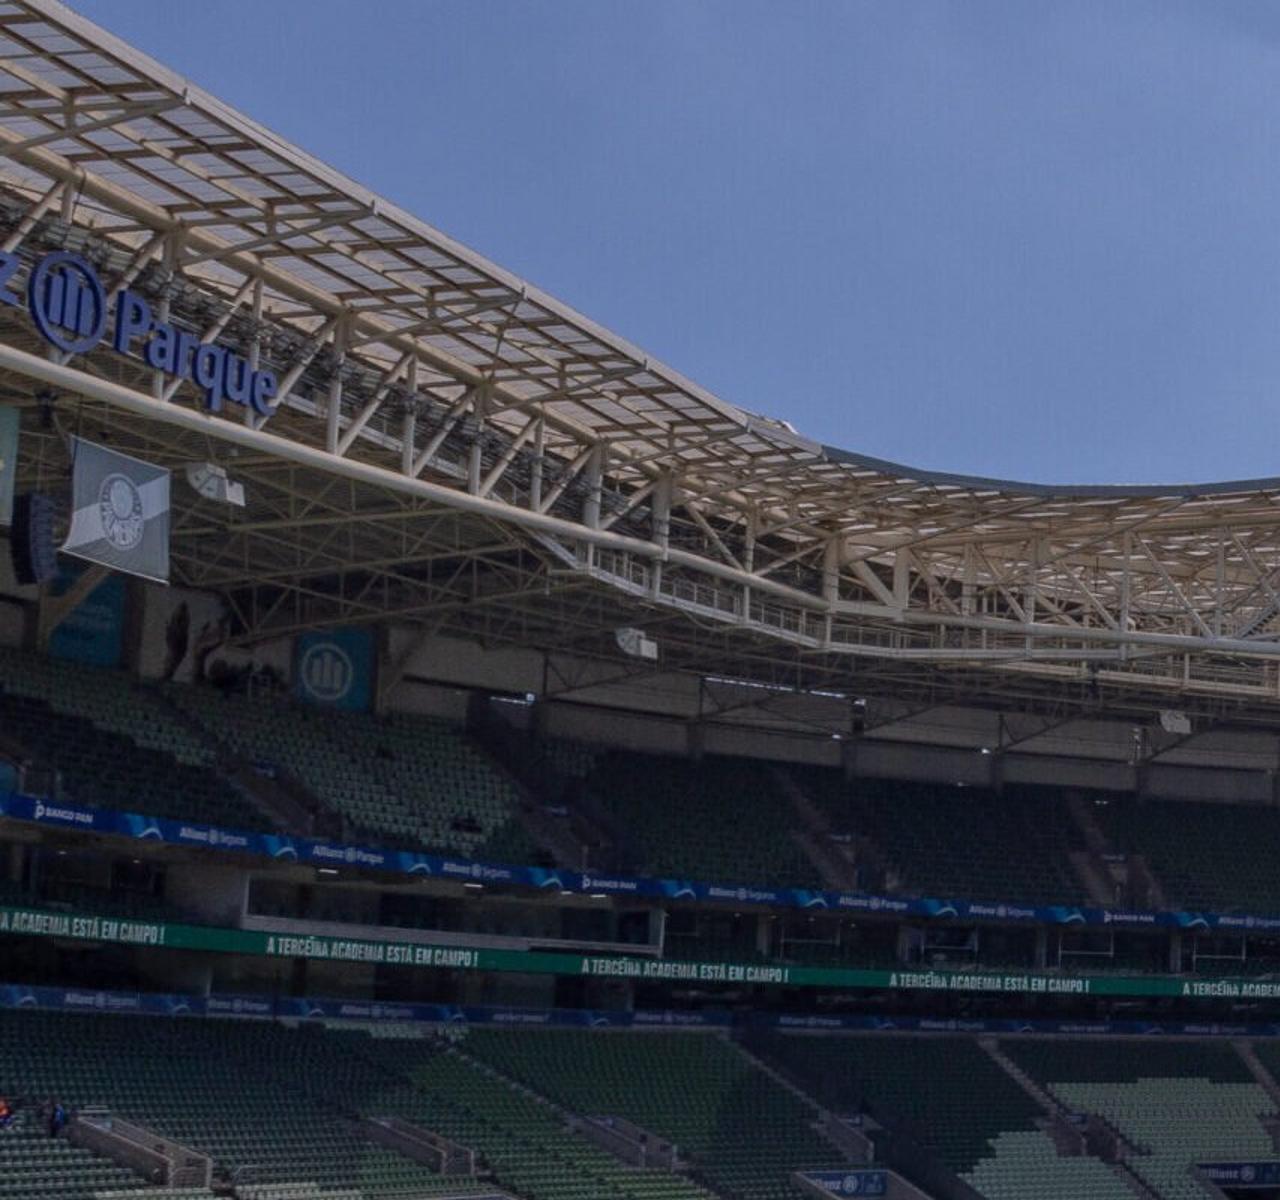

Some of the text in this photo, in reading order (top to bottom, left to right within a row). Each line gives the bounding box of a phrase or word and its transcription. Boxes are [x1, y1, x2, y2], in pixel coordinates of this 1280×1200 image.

[113, 289, 278, 417] Parque
[312, 844, 384, 865] Allianz Parque
[12, 912, 70, 936] ACADEMIA
[101, 920, 118, 940] EM
[120, 922, 158, 944] CAMPO
[266, 936, 276, 954] A
[330, 941, 384, 962] ACADEMIA
[416, 948, 432, 965] EM
[434, 948, 471, 967] CAMPO
[581, 958, 590, 973] A
[643, 961, 698, 980] ACADEMIA
[728, 967, 744, 981] EM
[746, 967, 782, 982] CAMPO
[889, 973, 898, 988] A
[950, 975, 1002, 991] ACADEMIA
[1031, 979, 1047, 991] EM
[1048, 978, 1082, 993] CAMPO
[1183, 983, 1191, 996] A
